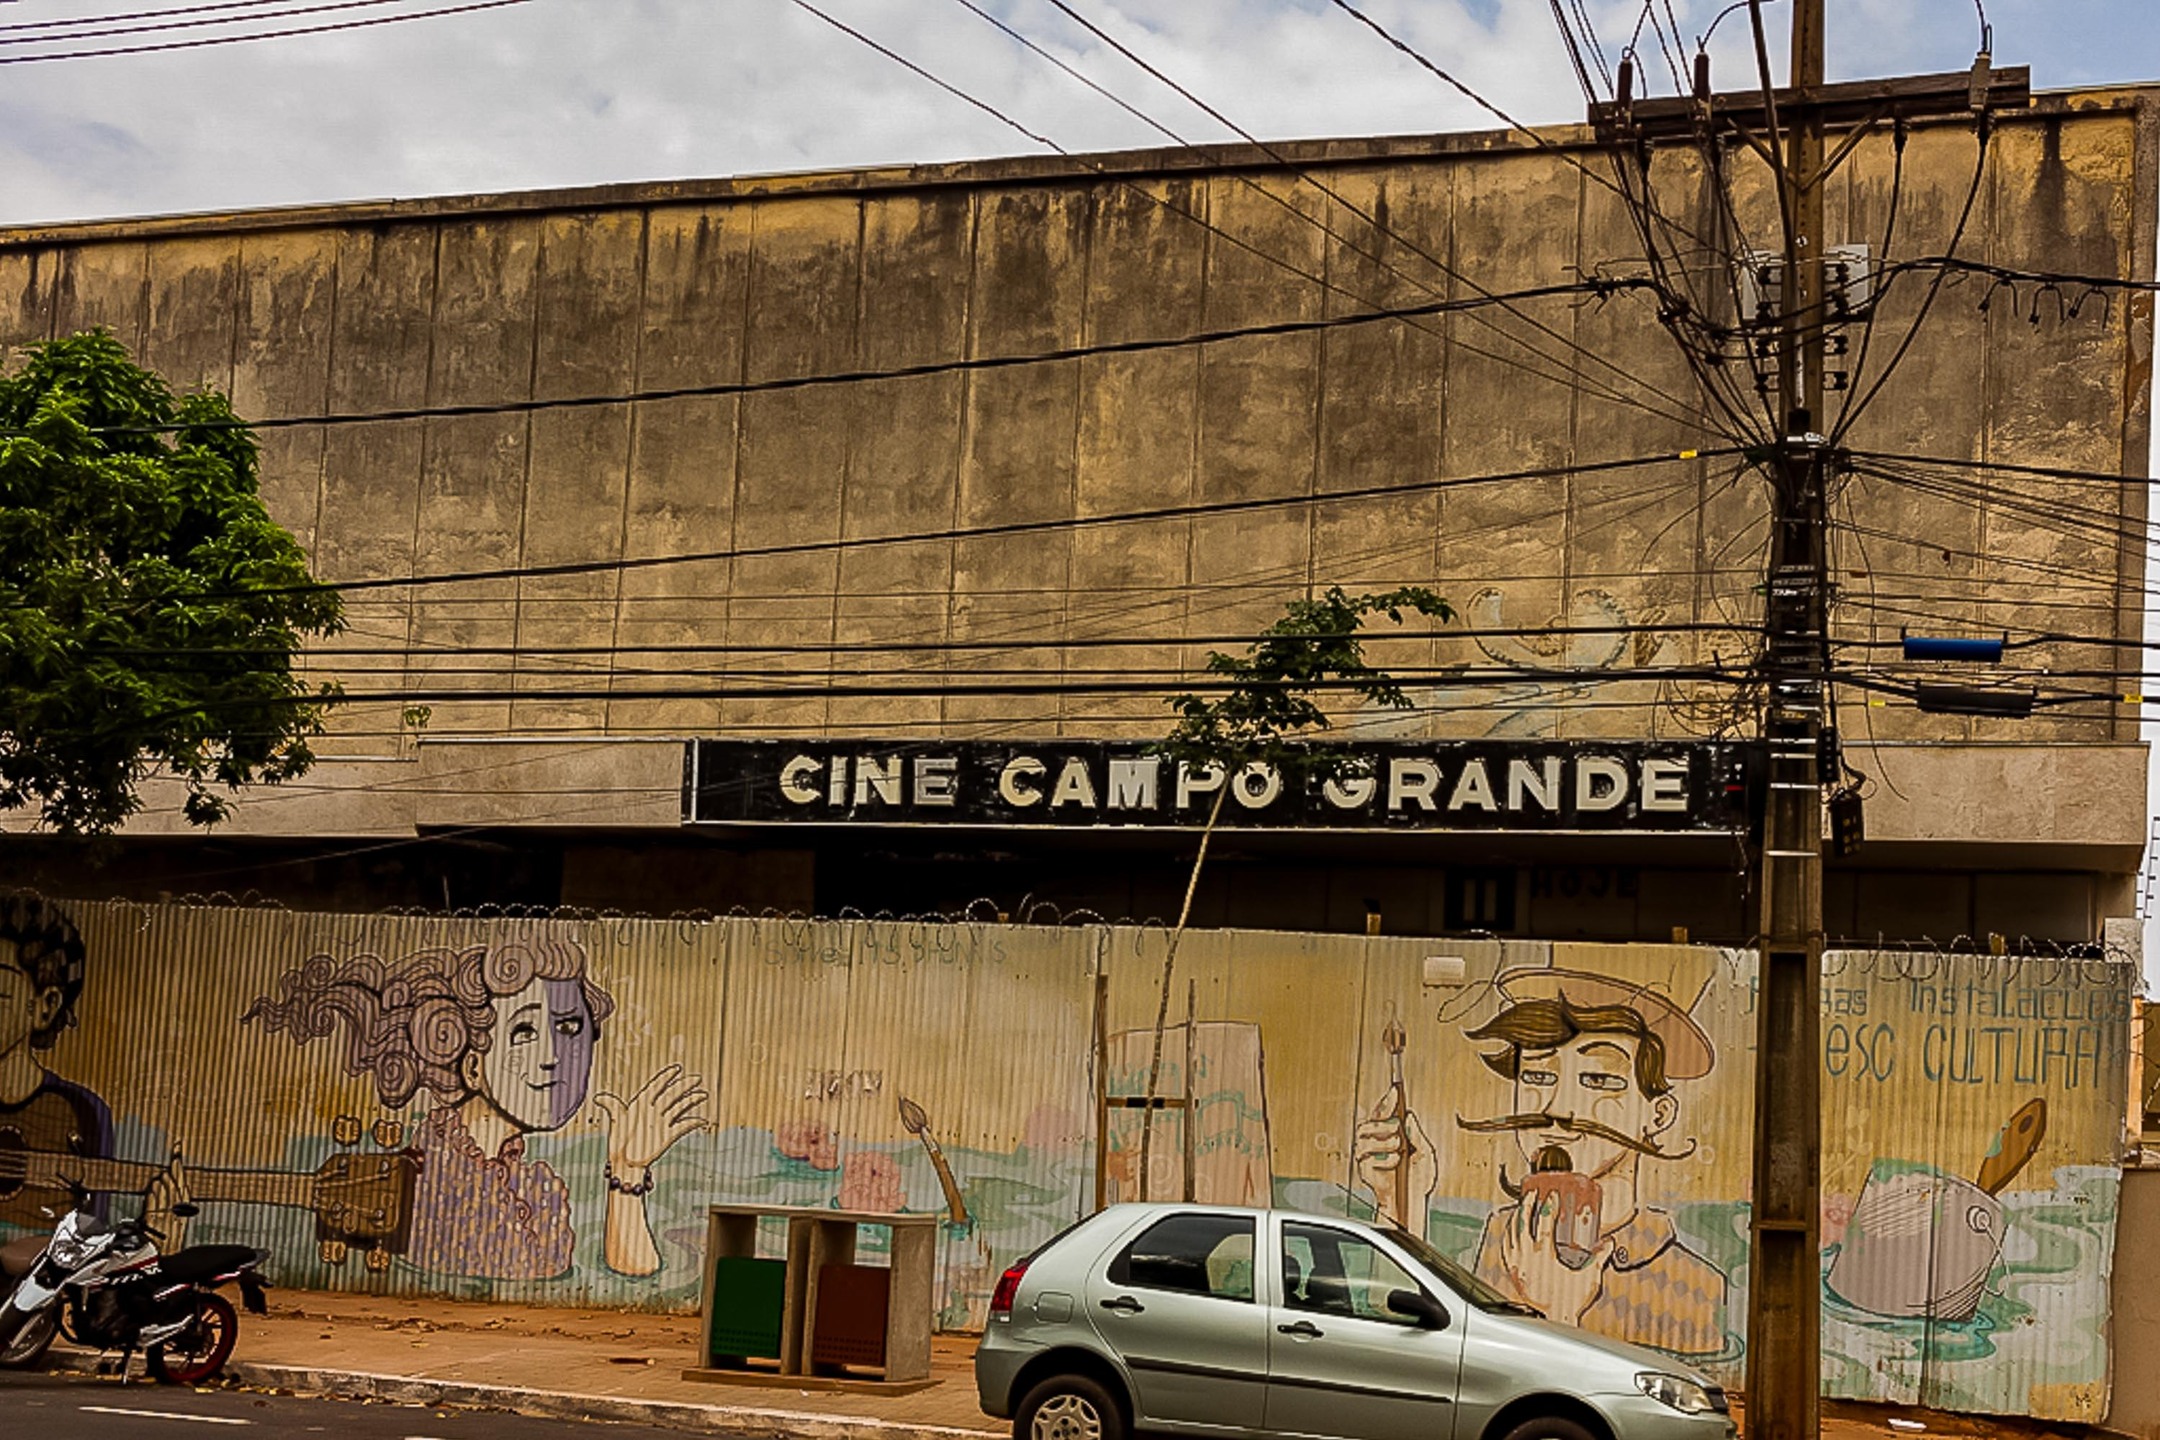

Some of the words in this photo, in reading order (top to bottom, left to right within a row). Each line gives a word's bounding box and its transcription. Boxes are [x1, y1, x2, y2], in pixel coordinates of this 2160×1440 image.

[779, 755, 958, 806] CINE
[999, 757, 1283, 809] CAMPO
[1322, 757, 1690, 812] GRANDE
[1531, 868, 1639, 899] HOJE
[1825, 1022, 1895, 1082] esc
[1923, 1022, 2101, 1090] CULTURA
